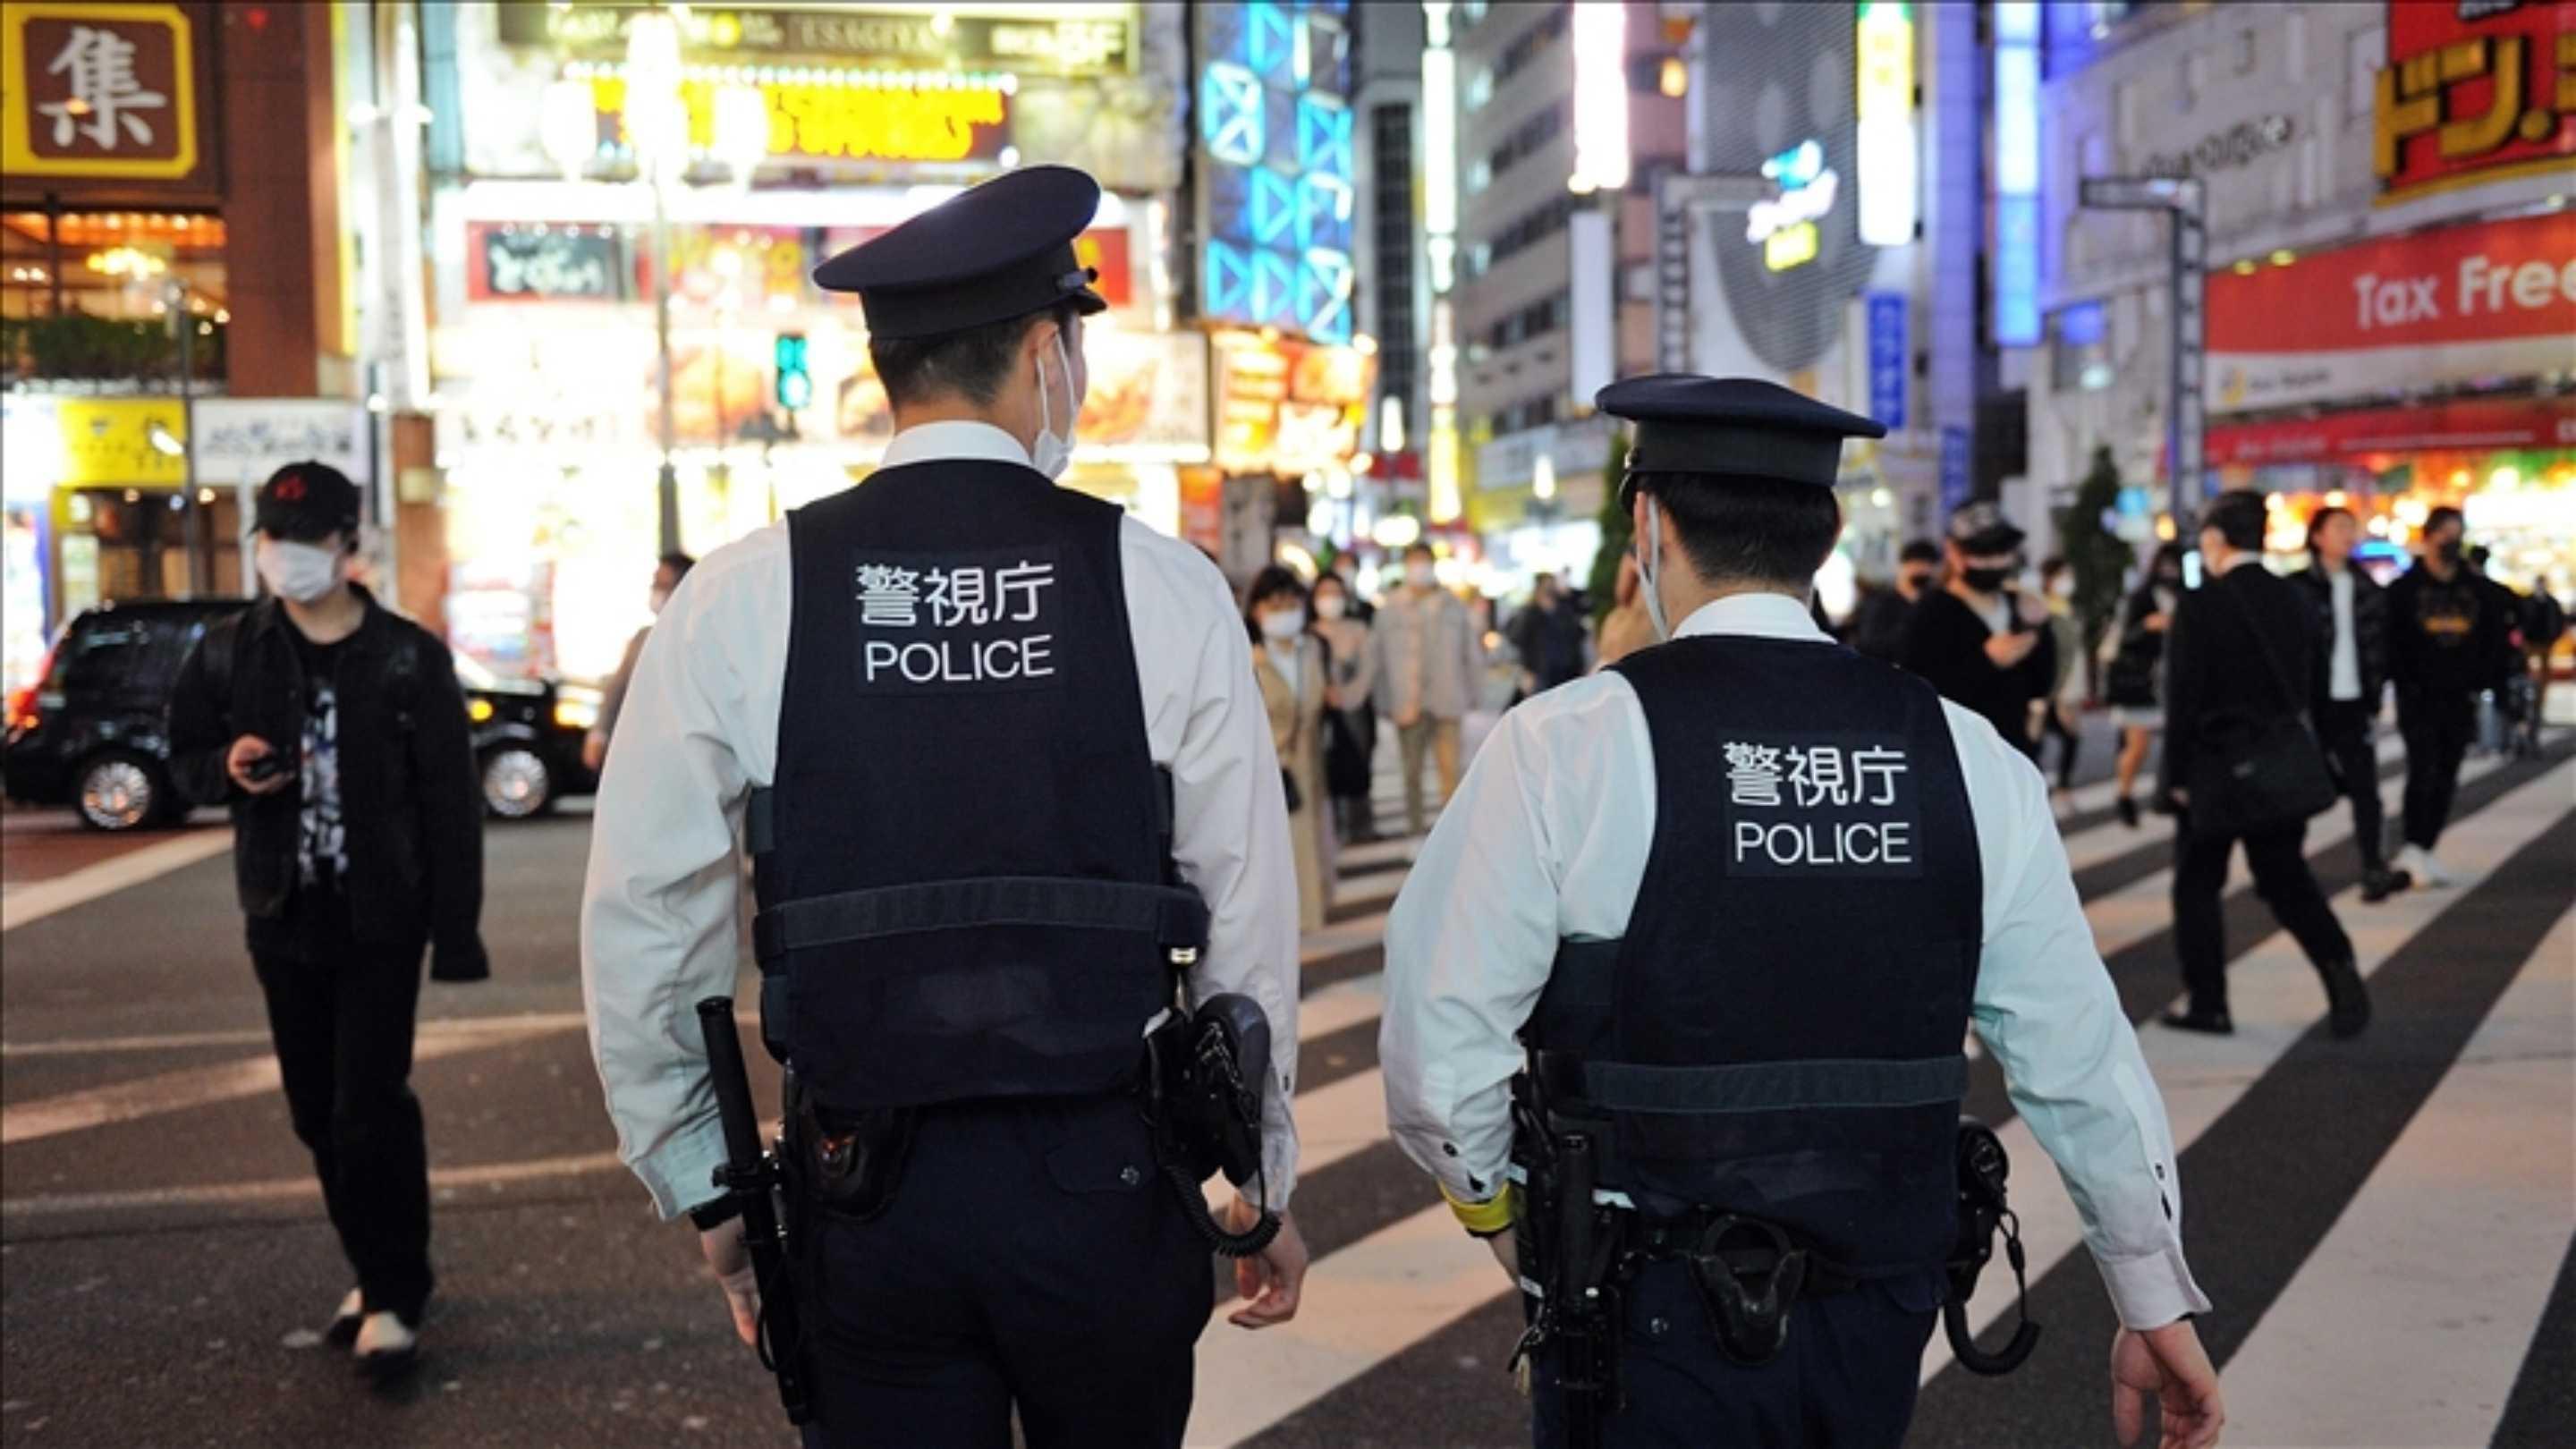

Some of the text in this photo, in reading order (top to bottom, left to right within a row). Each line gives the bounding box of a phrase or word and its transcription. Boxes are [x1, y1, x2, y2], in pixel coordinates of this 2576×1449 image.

[38, 25, 167, 151] 集
[2353, 272, 2439, 330] Tax
[856, 560, 1055, 627] 警視庁
[864, 634, 1055, 683] POLICE
[1723, 741, 1908, 807] 警視庁
[1735, 822, 1912, 865] POLICE
